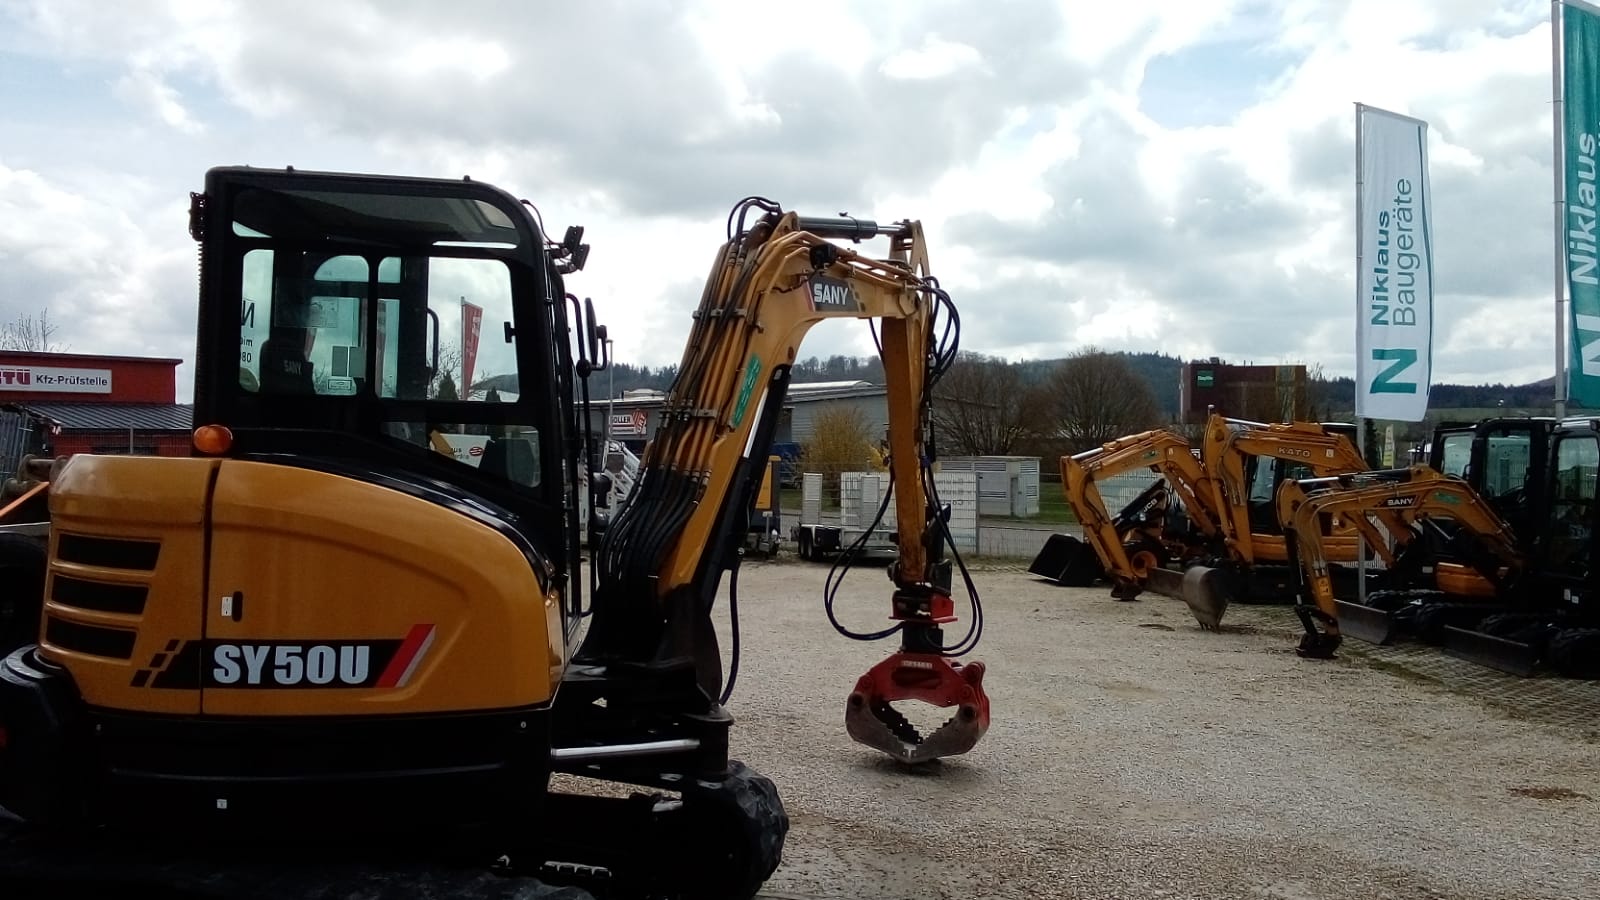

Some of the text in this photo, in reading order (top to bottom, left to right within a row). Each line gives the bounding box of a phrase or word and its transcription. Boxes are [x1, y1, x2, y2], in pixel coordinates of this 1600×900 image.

[1569, 132, 1598, 285] Niklaus
[1371, 210, 1390, 326] Niklaus
[1393, 178, 1420, 326] Baugeräte
[814, 283, 849, 305] SANY
[0, 368, 108, 386] TÜ Kfz-Prüfstelle
[1369, 348, 1417, 394] N
[1278, 447, 1312, 457] KATO
[1387, 498, 1414, 506] SANY
[213, 644, 370, 685] SY50U
